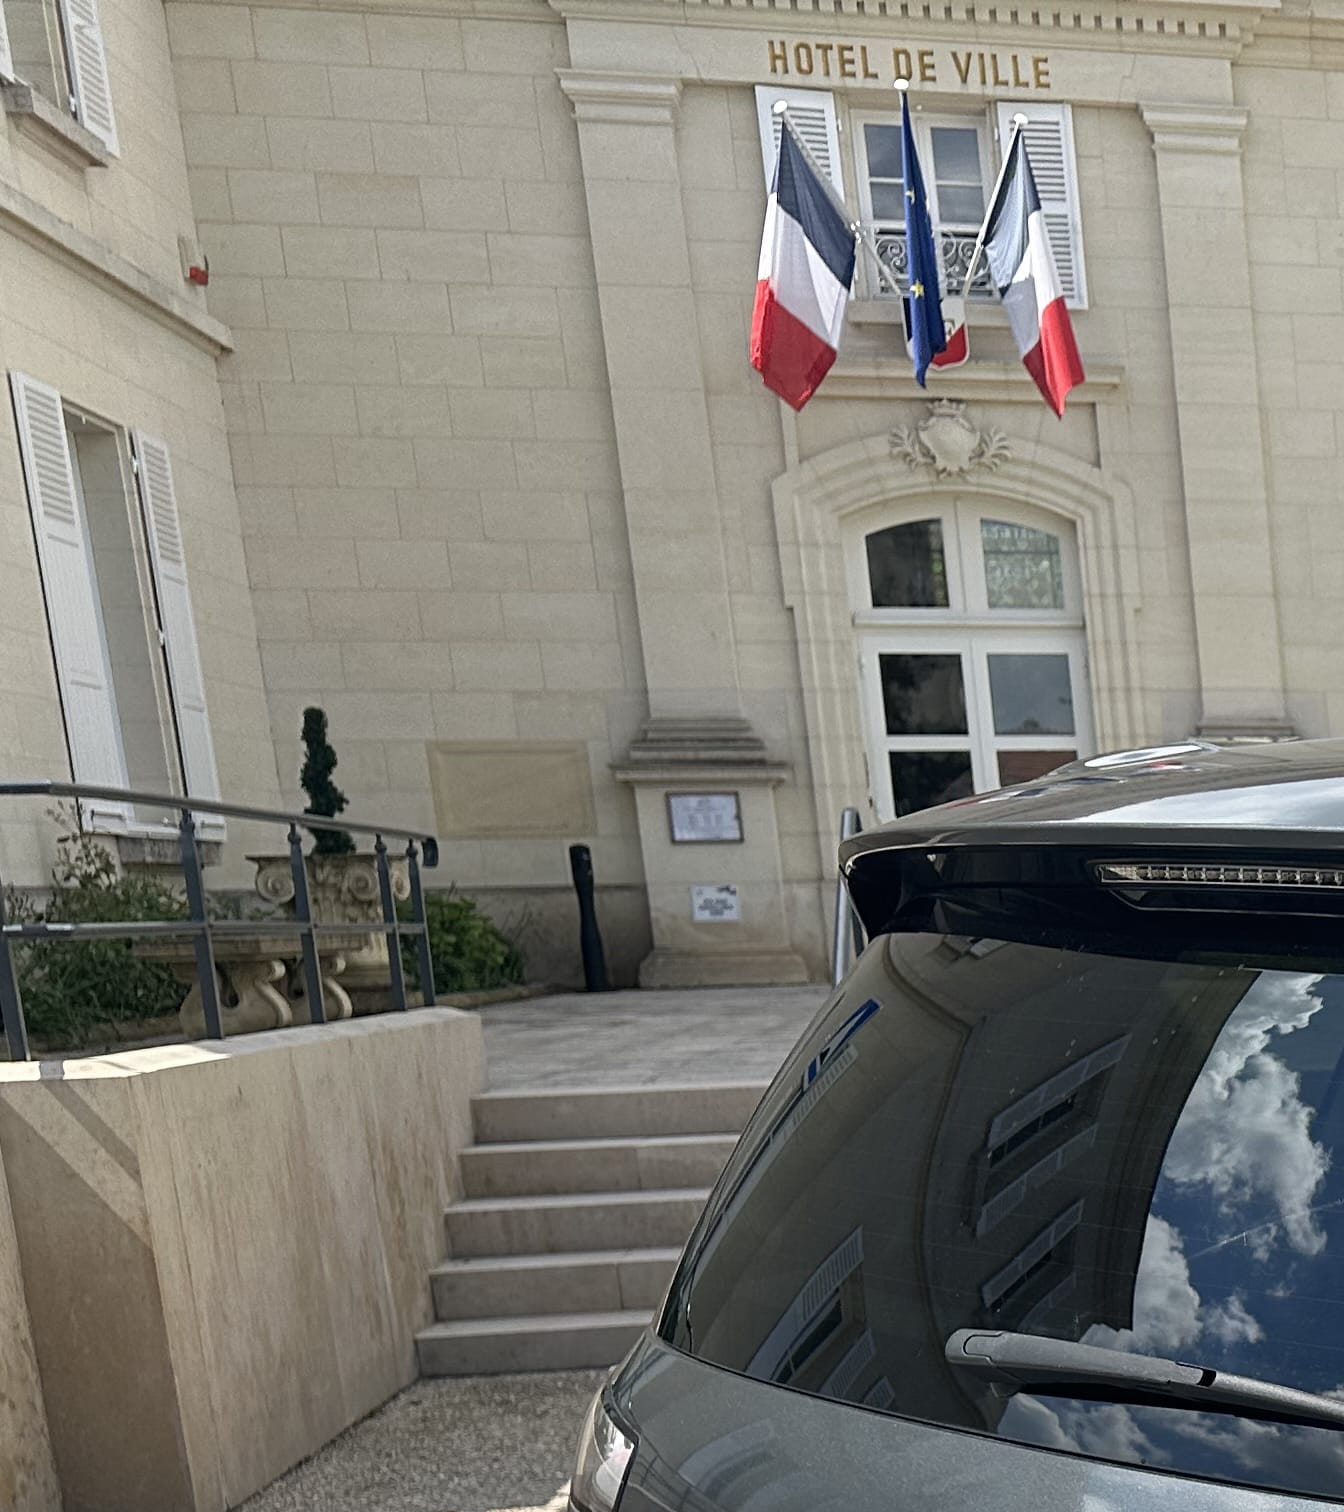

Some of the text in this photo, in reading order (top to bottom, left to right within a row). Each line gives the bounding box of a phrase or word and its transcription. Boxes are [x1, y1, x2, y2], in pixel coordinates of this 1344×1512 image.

[766, 39, 1053, 89] HOTEL DE VILLE
